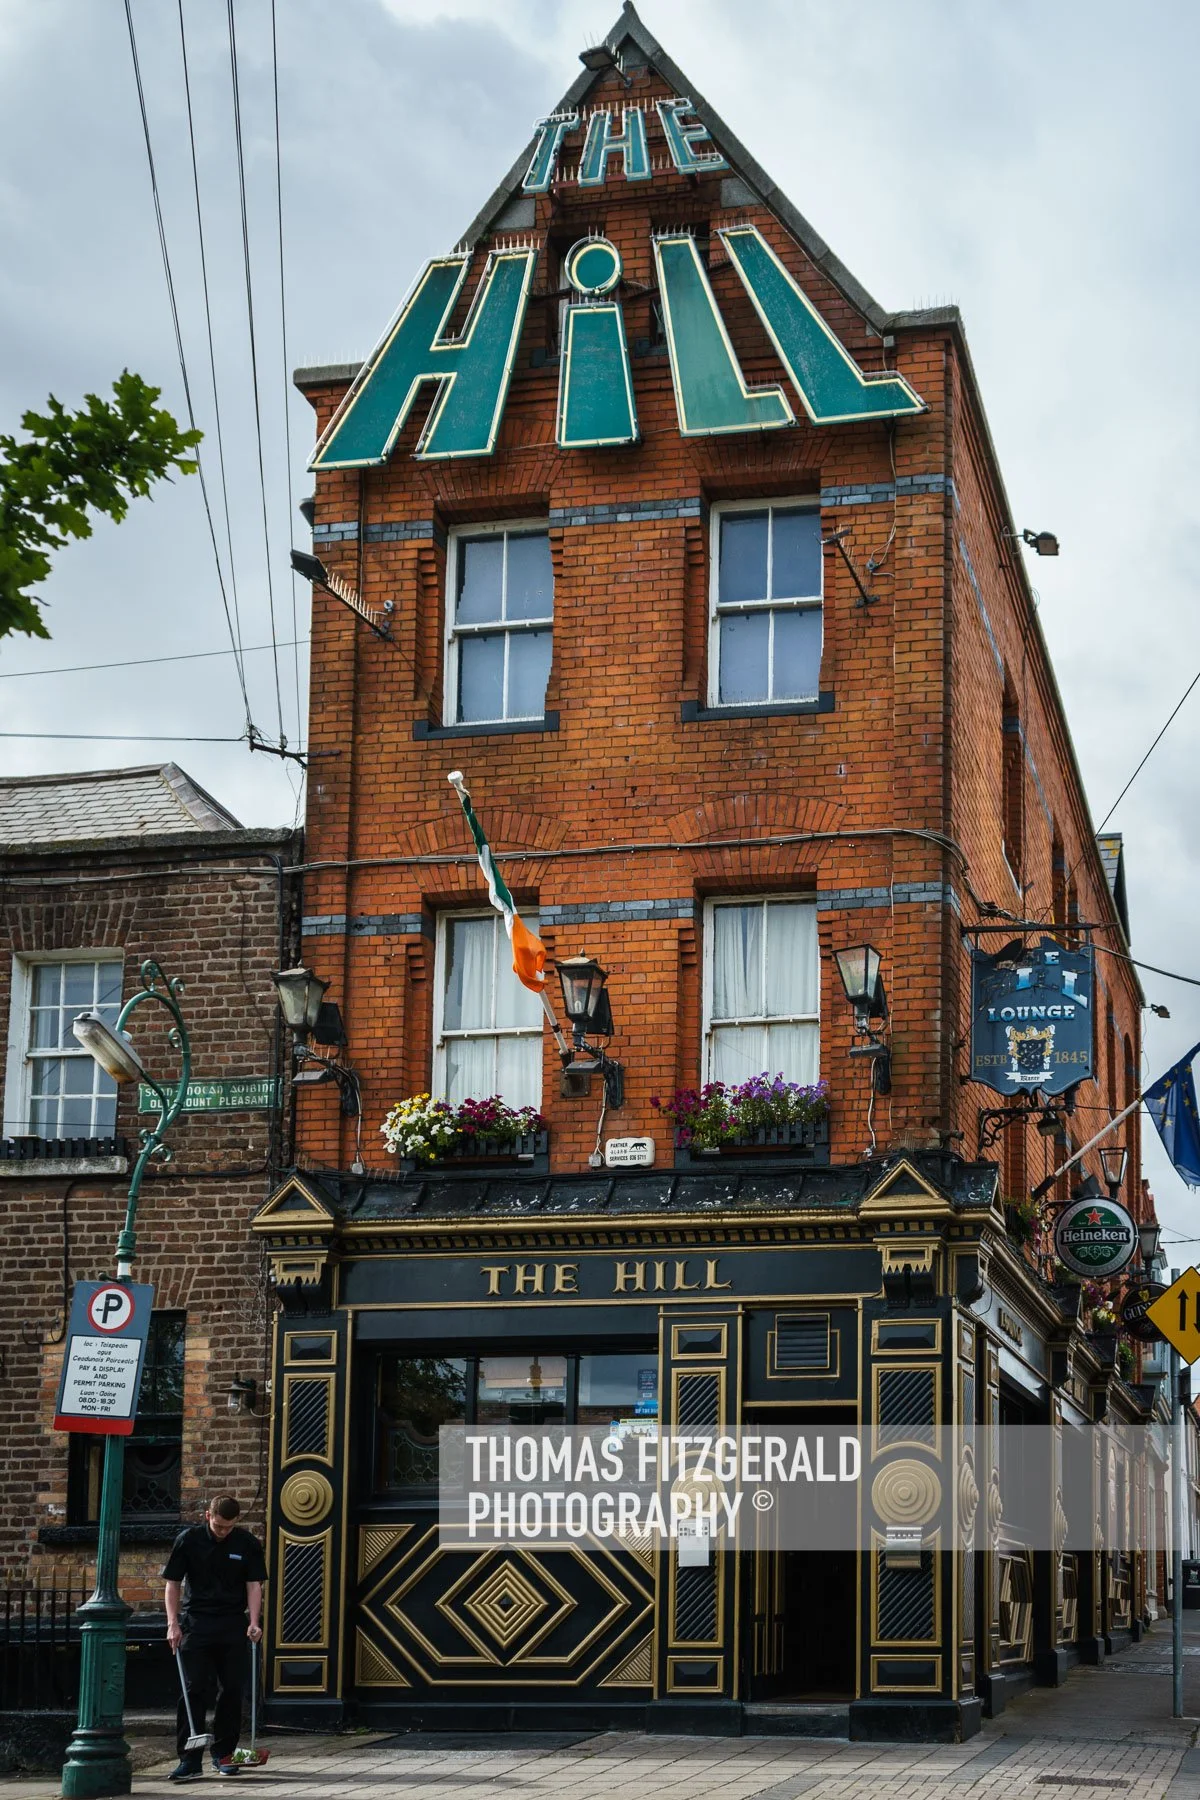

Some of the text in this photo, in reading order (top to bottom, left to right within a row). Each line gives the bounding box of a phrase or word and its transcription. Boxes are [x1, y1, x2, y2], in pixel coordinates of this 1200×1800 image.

[522, 97, 729, 193] THE
[987, 1005, 1075, 1022] LOUNGE
[1054, 1051, 1088, 1064] 1845
[183, 1097, 212, 1107] OUNT
[219, 1095, 268, 1106] PLEASANT
[1063, 1229, 1128, 1242] Heineken
[480, 1258, 732, 1296] THE HILL
[102, 1294, 123, 1324] P
